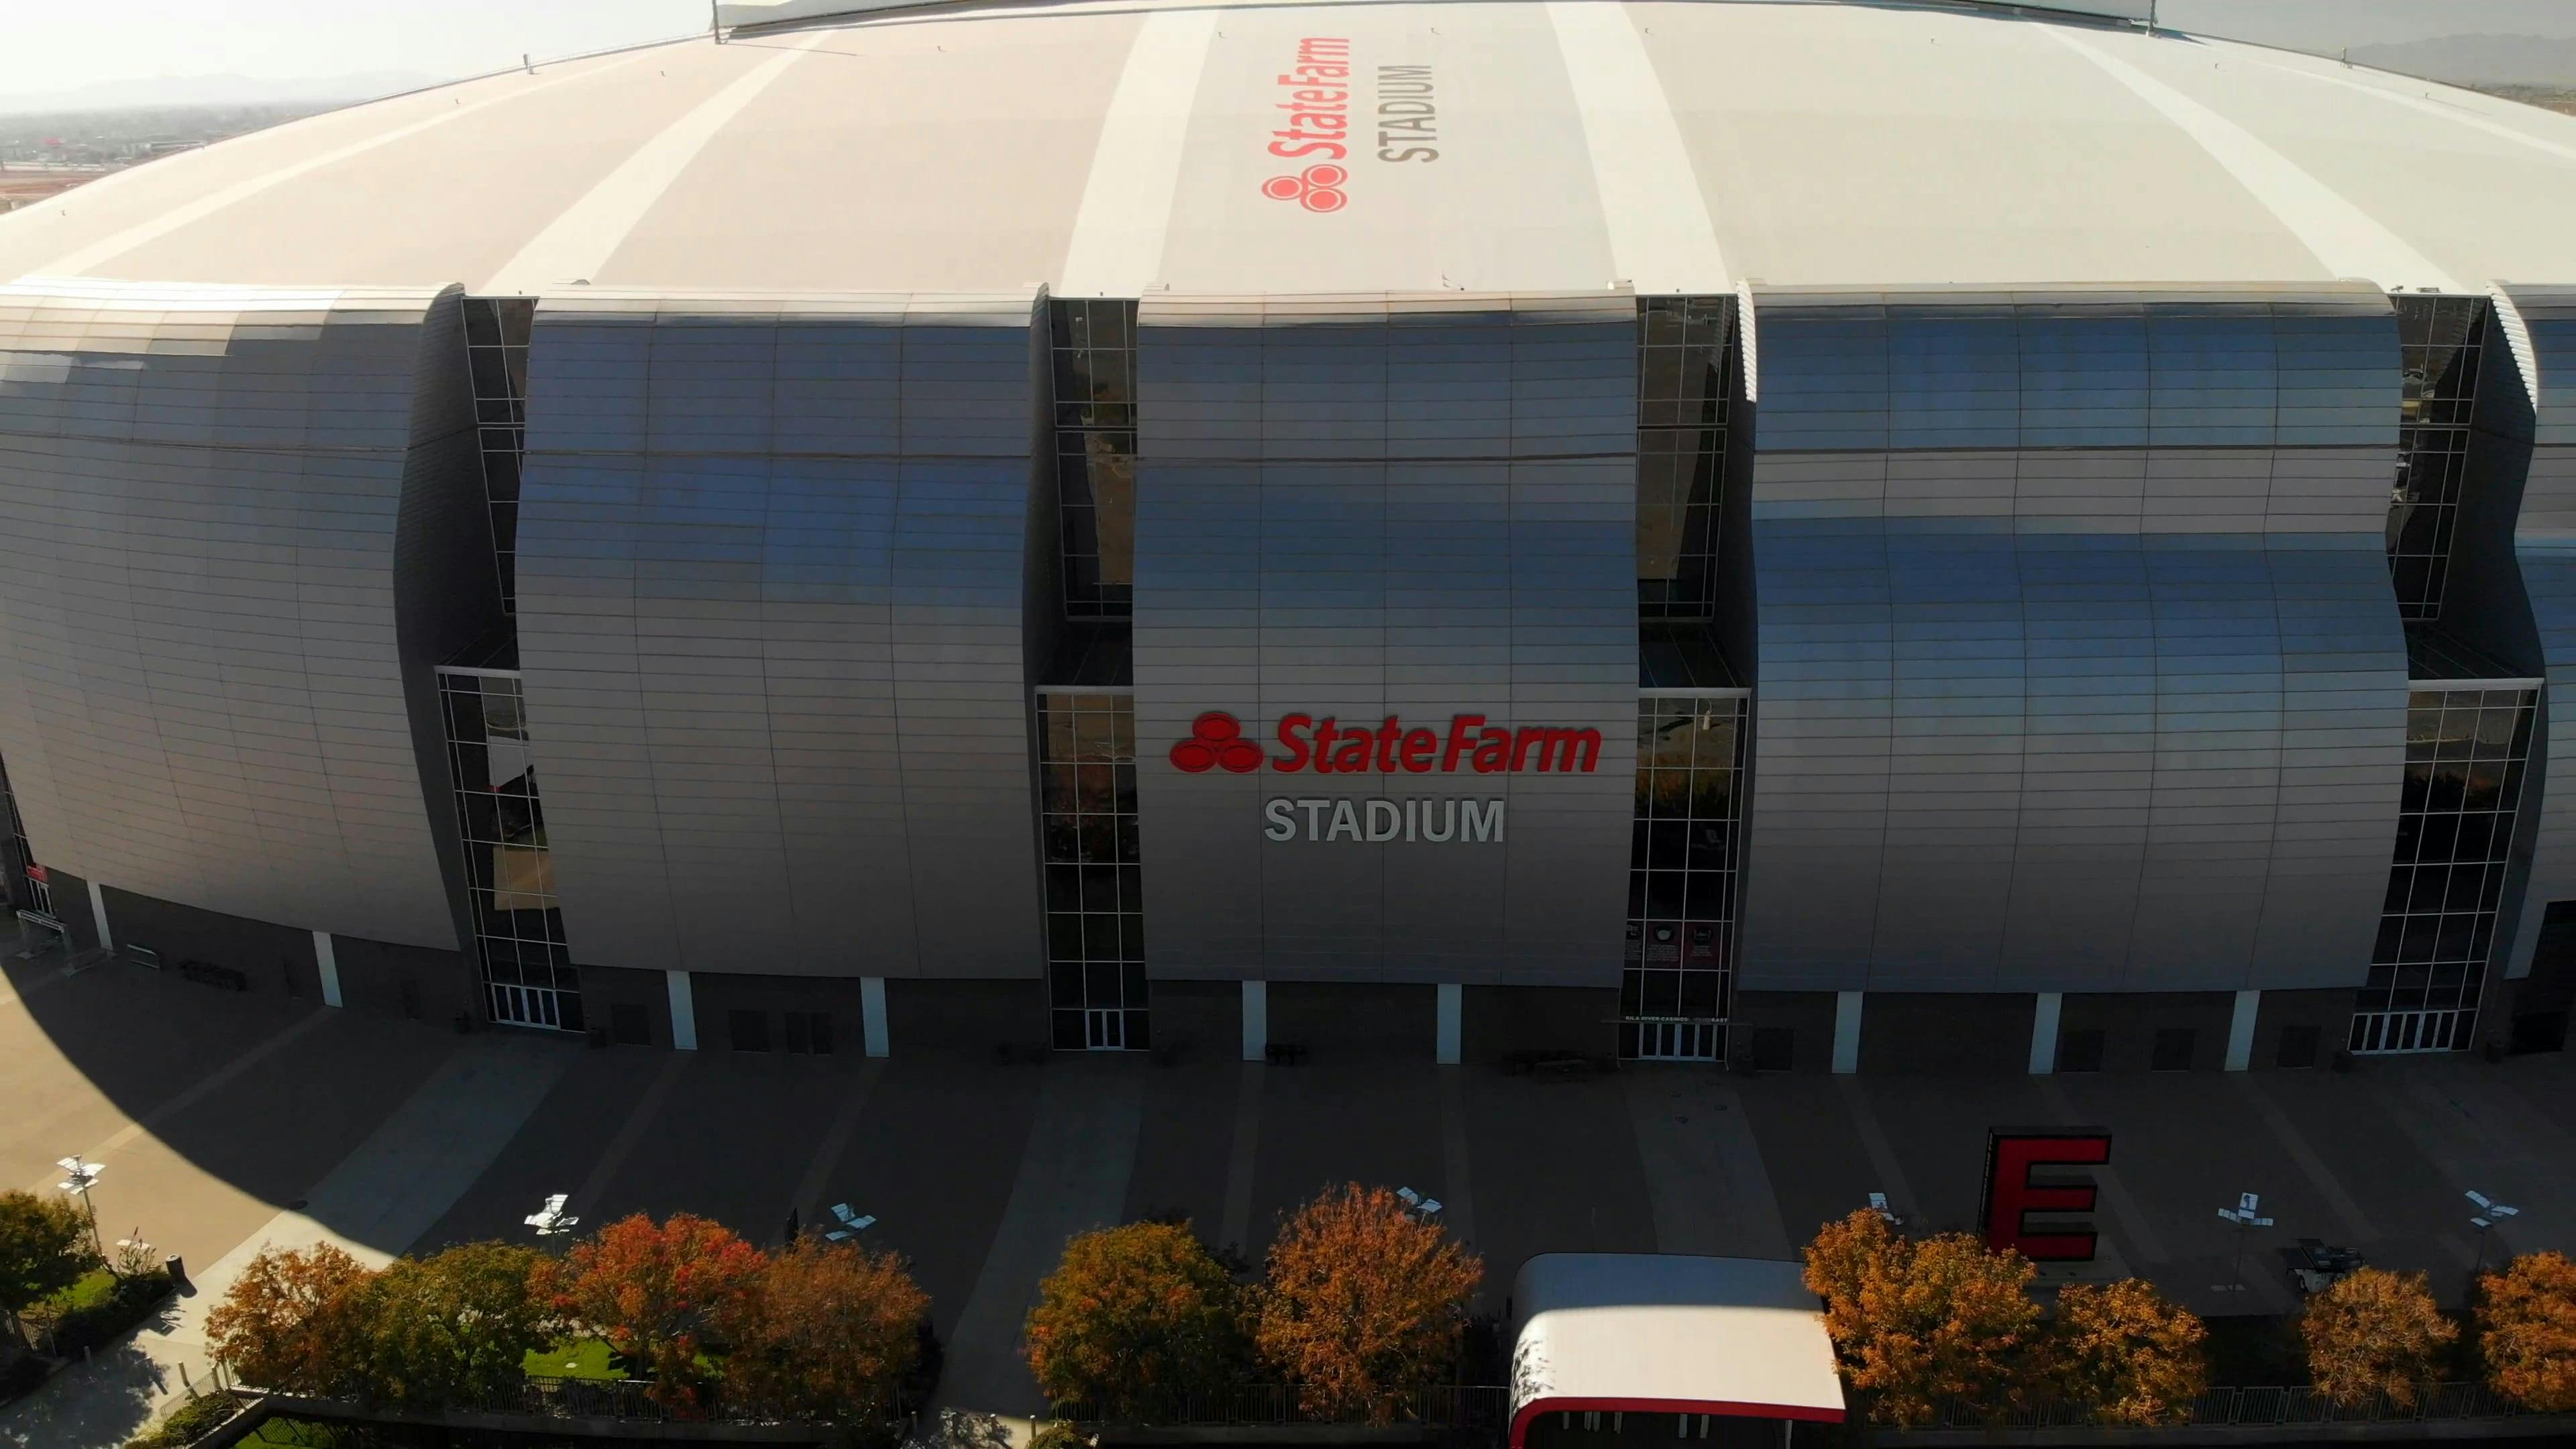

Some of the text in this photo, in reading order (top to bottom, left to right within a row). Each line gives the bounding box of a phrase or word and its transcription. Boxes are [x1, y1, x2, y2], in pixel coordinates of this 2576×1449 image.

[1377, 66, 1439, 162] STADIUM
[1264, 799, 1505, 843] STADIUM
[1982, 1132, 2111, 1261] E
